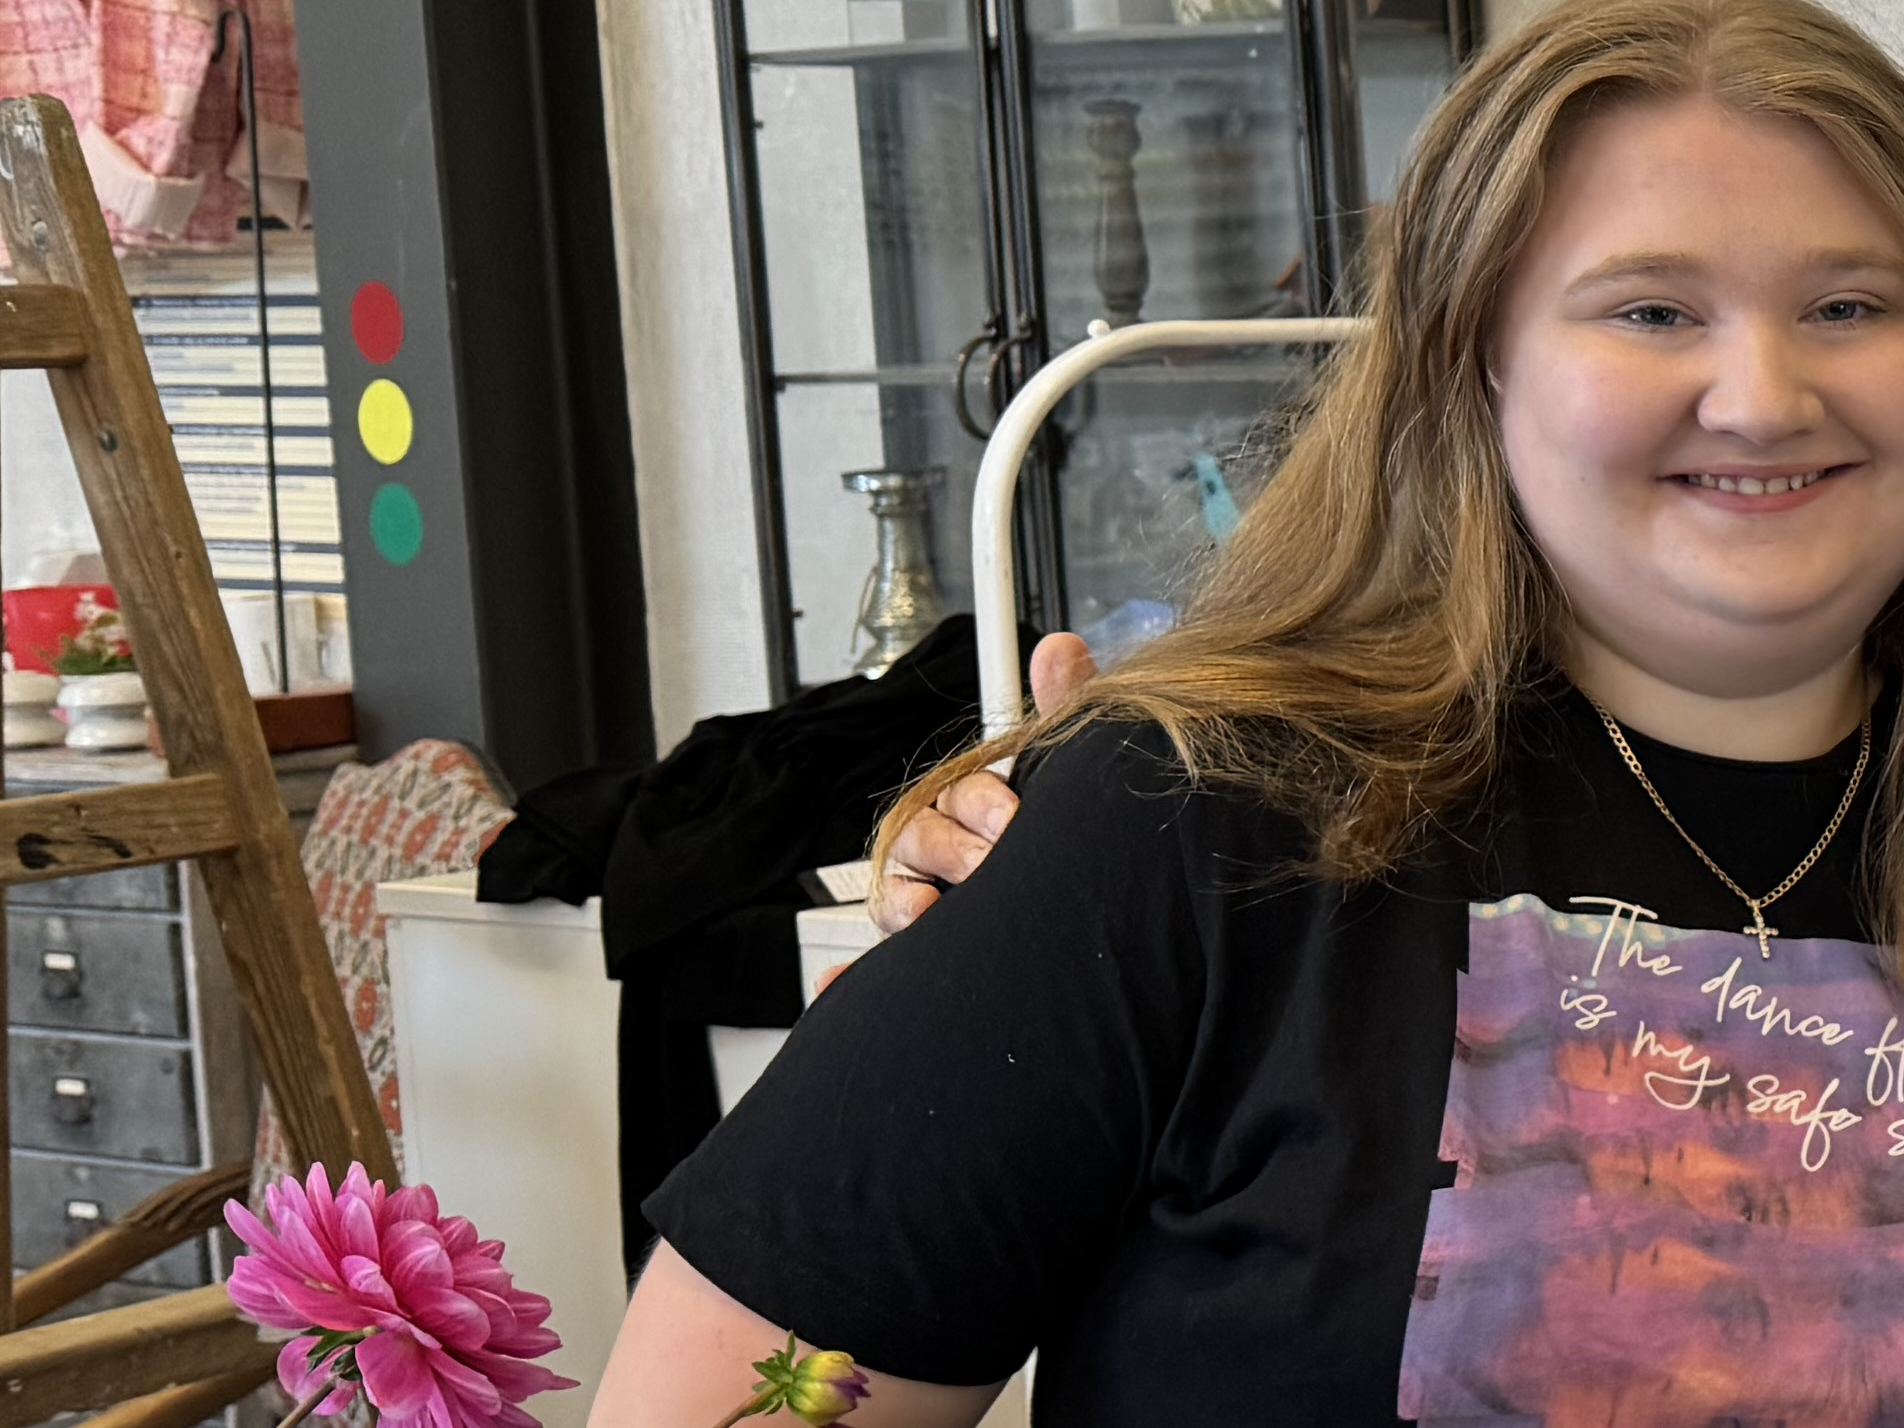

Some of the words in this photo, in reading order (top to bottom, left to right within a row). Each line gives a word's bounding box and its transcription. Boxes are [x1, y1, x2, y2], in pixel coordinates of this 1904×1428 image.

[1569, 896, 1682, 977] The
[1701, 957, 1854, 1046] dance
[1560, 975, 1617, 1030] is
[1633, 1021, 1730, 1110] my
[1746, 1073, 1862, 1172] safe
